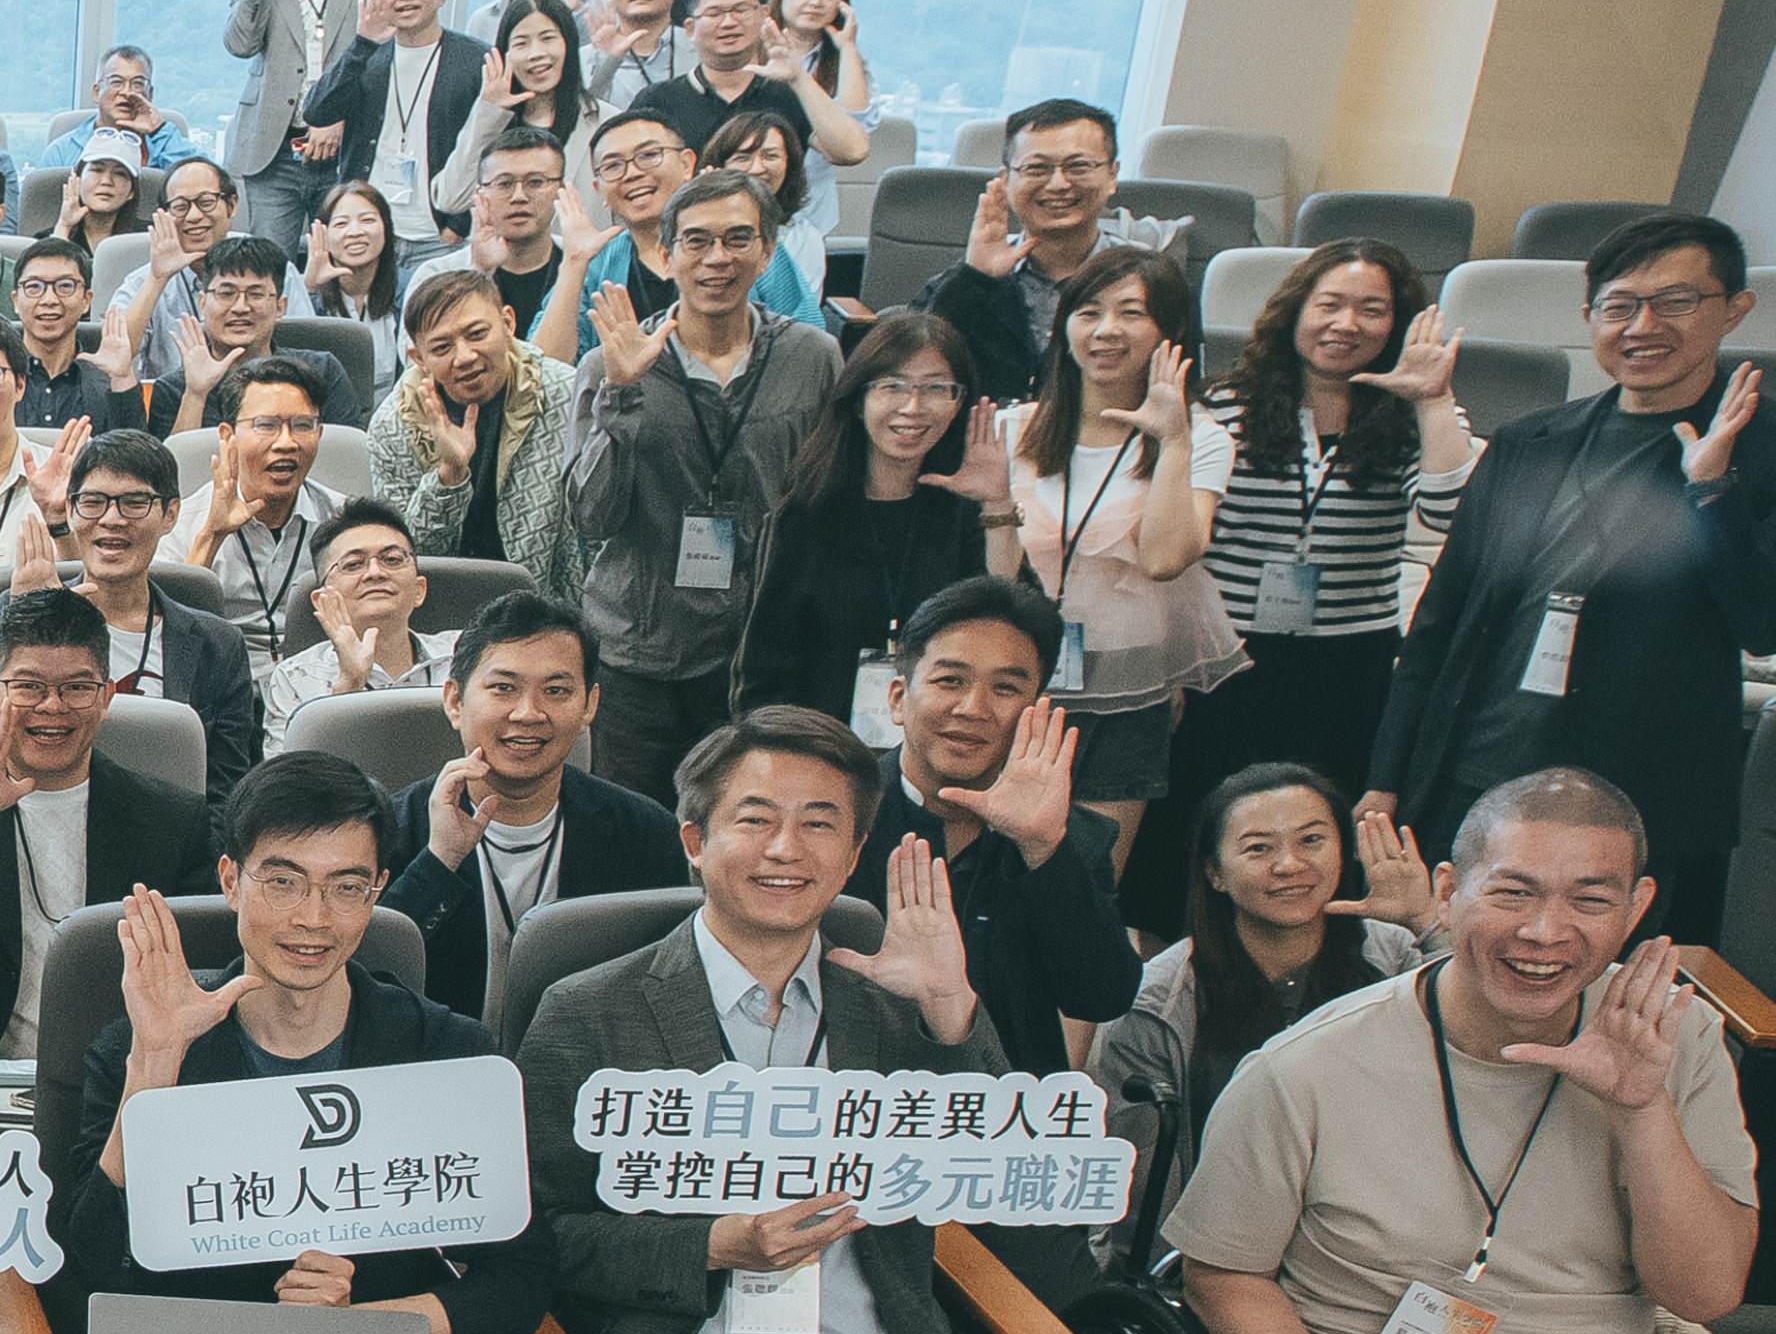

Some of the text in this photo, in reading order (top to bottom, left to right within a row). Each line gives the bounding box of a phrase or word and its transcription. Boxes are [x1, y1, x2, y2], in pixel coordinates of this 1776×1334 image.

[590, 1079, 1093, 1140] 打造自己的差異人生
[187, 1151, 483, 1225] 白袍人生學院
[612, 1150, 1123, 1213] 掌控自己的多元職涯
[191, 1213, 487, 1254] White Coat Life Academy
